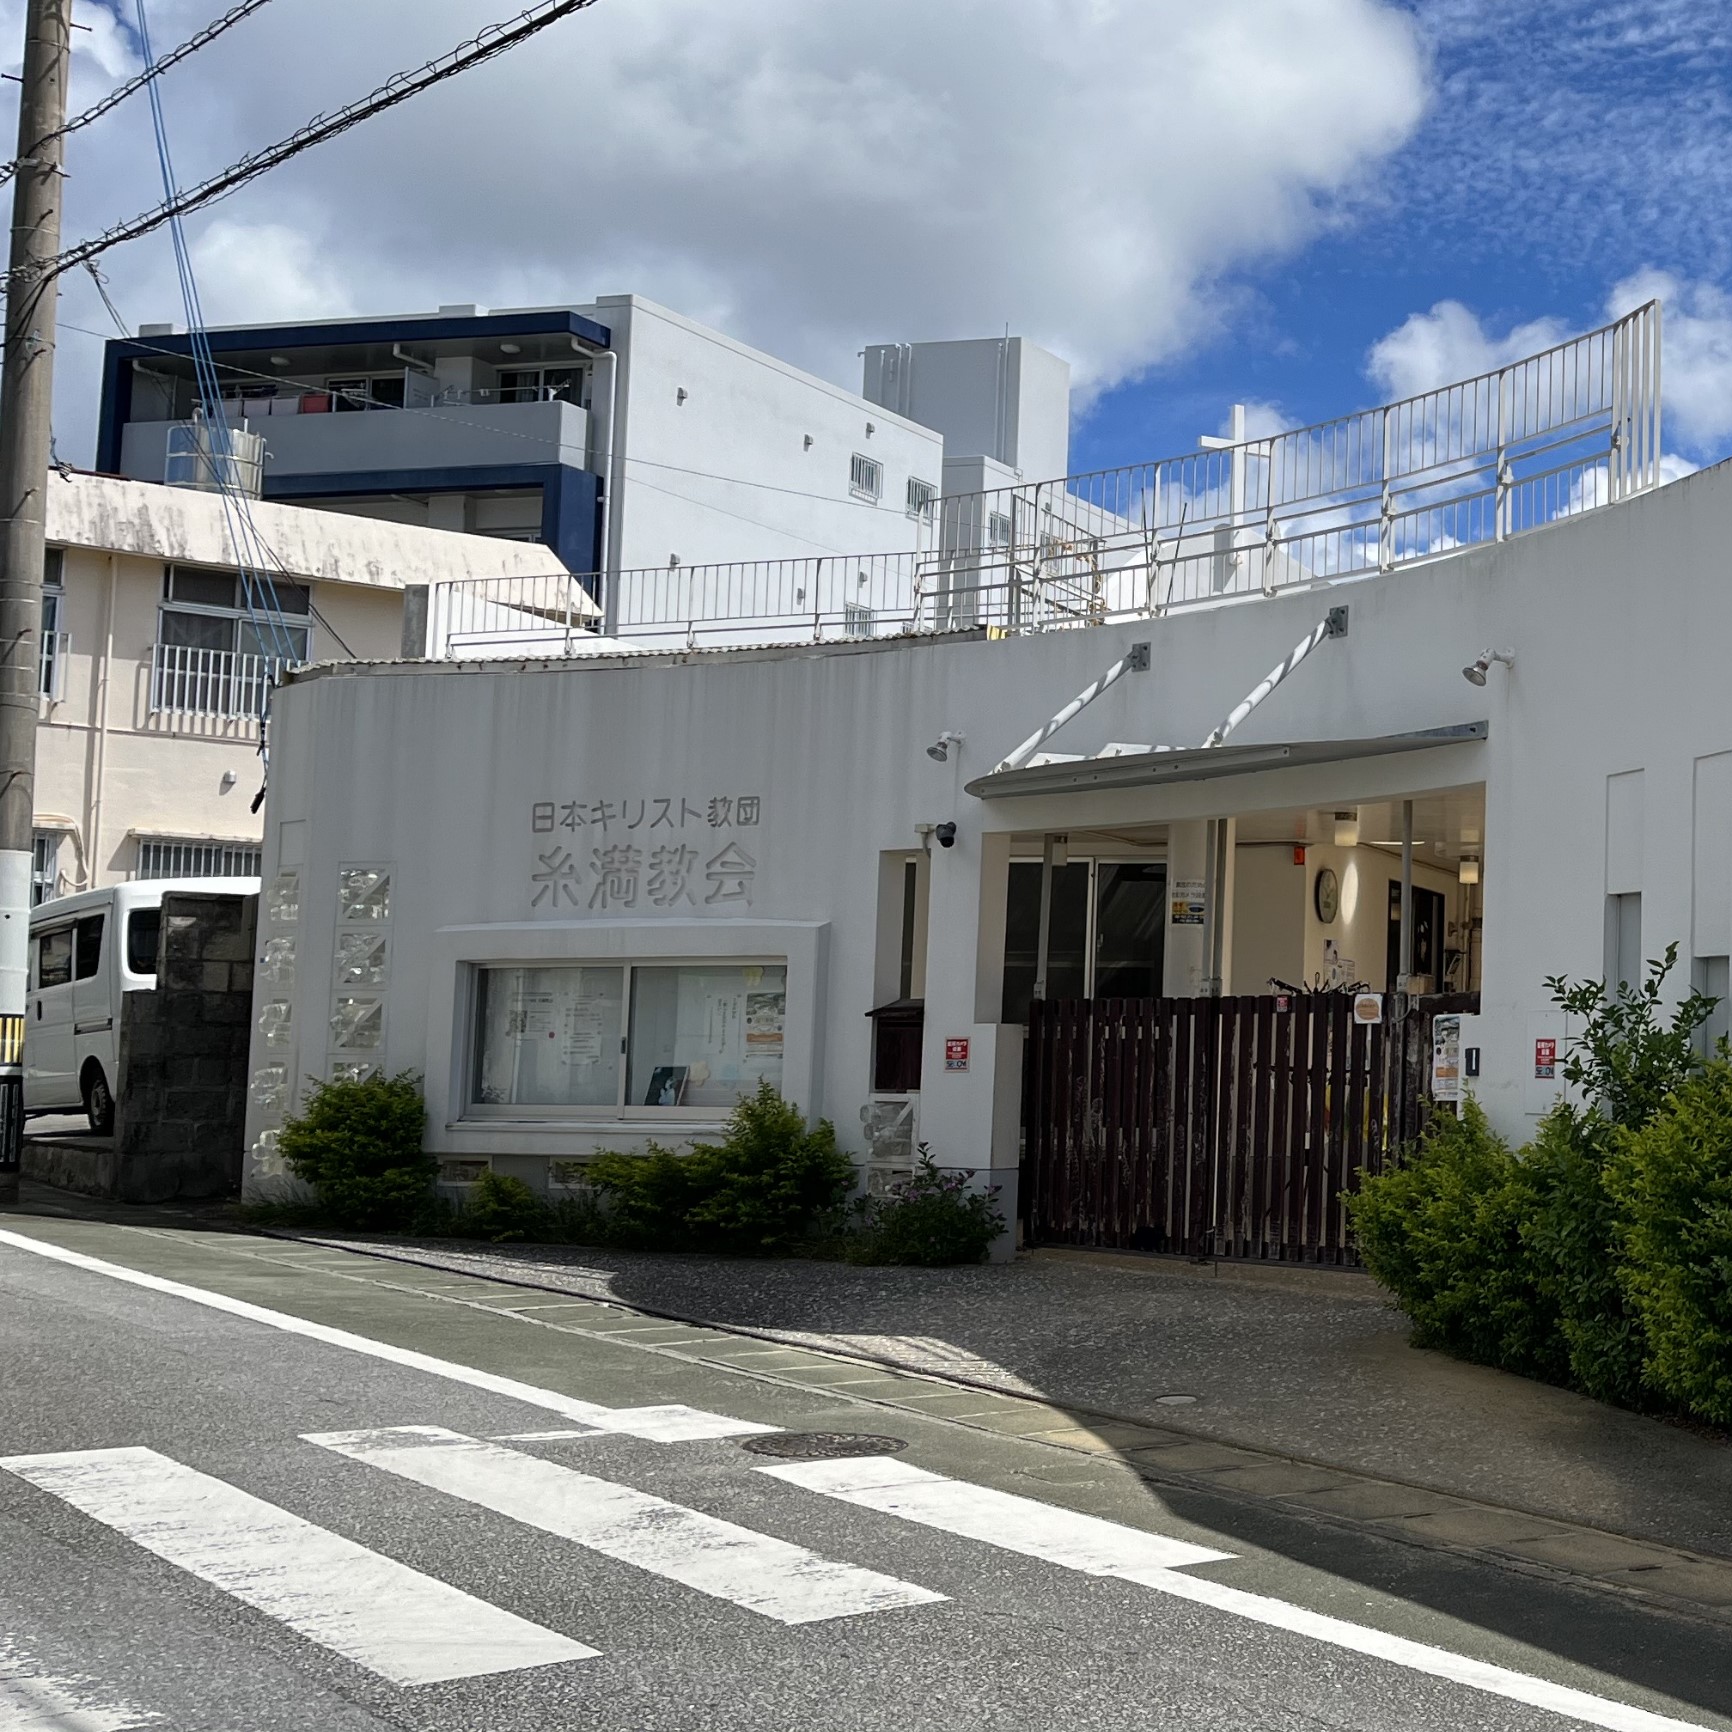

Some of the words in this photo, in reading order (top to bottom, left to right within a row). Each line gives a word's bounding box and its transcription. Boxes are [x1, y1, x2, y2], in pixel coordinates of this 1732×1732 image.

[531, 795, 761, 833] 日本キリスト教団
[531, 841, 757, 909] 糸満教会
